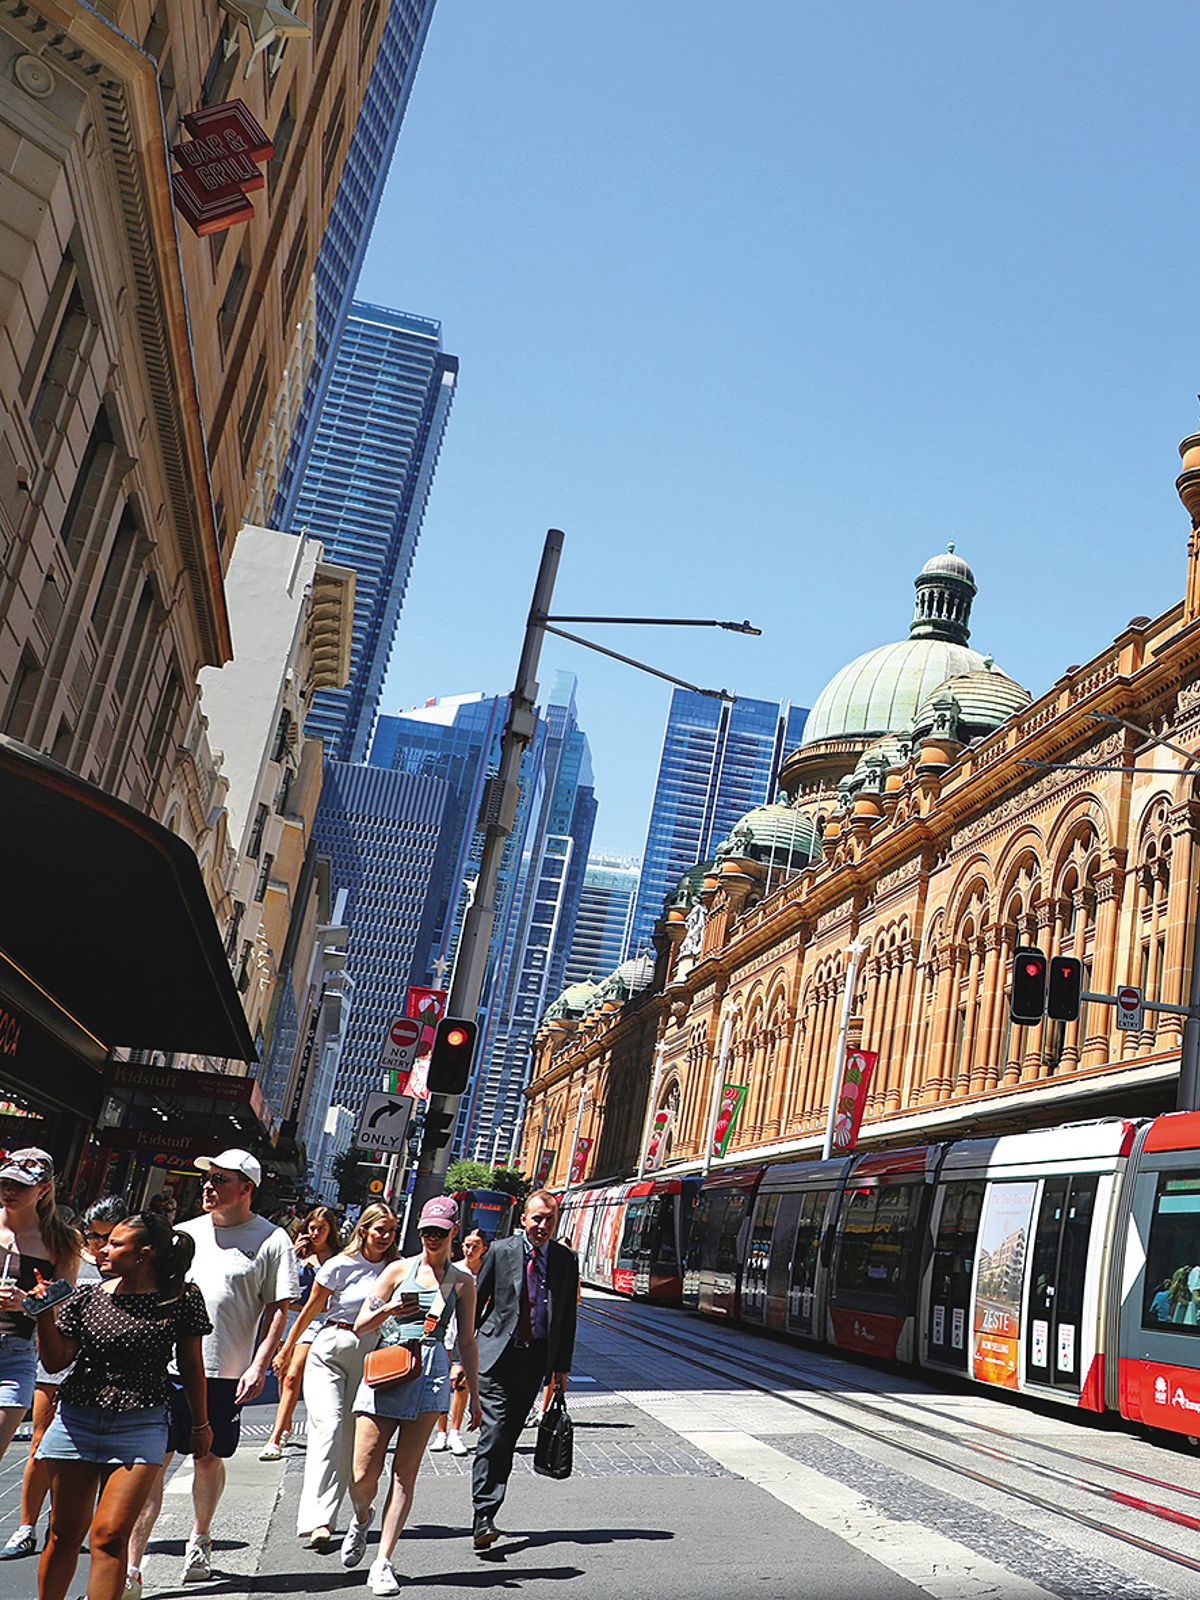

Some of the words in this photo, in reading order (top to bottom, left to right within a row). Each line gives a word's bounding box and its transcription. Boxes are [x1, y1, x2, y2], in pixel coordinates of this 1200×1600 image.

[180, 134, 228, 166] BAR
[195, 154, 260, 191] GRILL
[0, 1008, 21, 1058] CCA
[382, 1057, 411, 1068] ENTRY
[390, 1048, 408, 1059] NO
[361, 1132, 399, 1147] ONLY
[982, 1309, 1011, 1332] ZESTE
